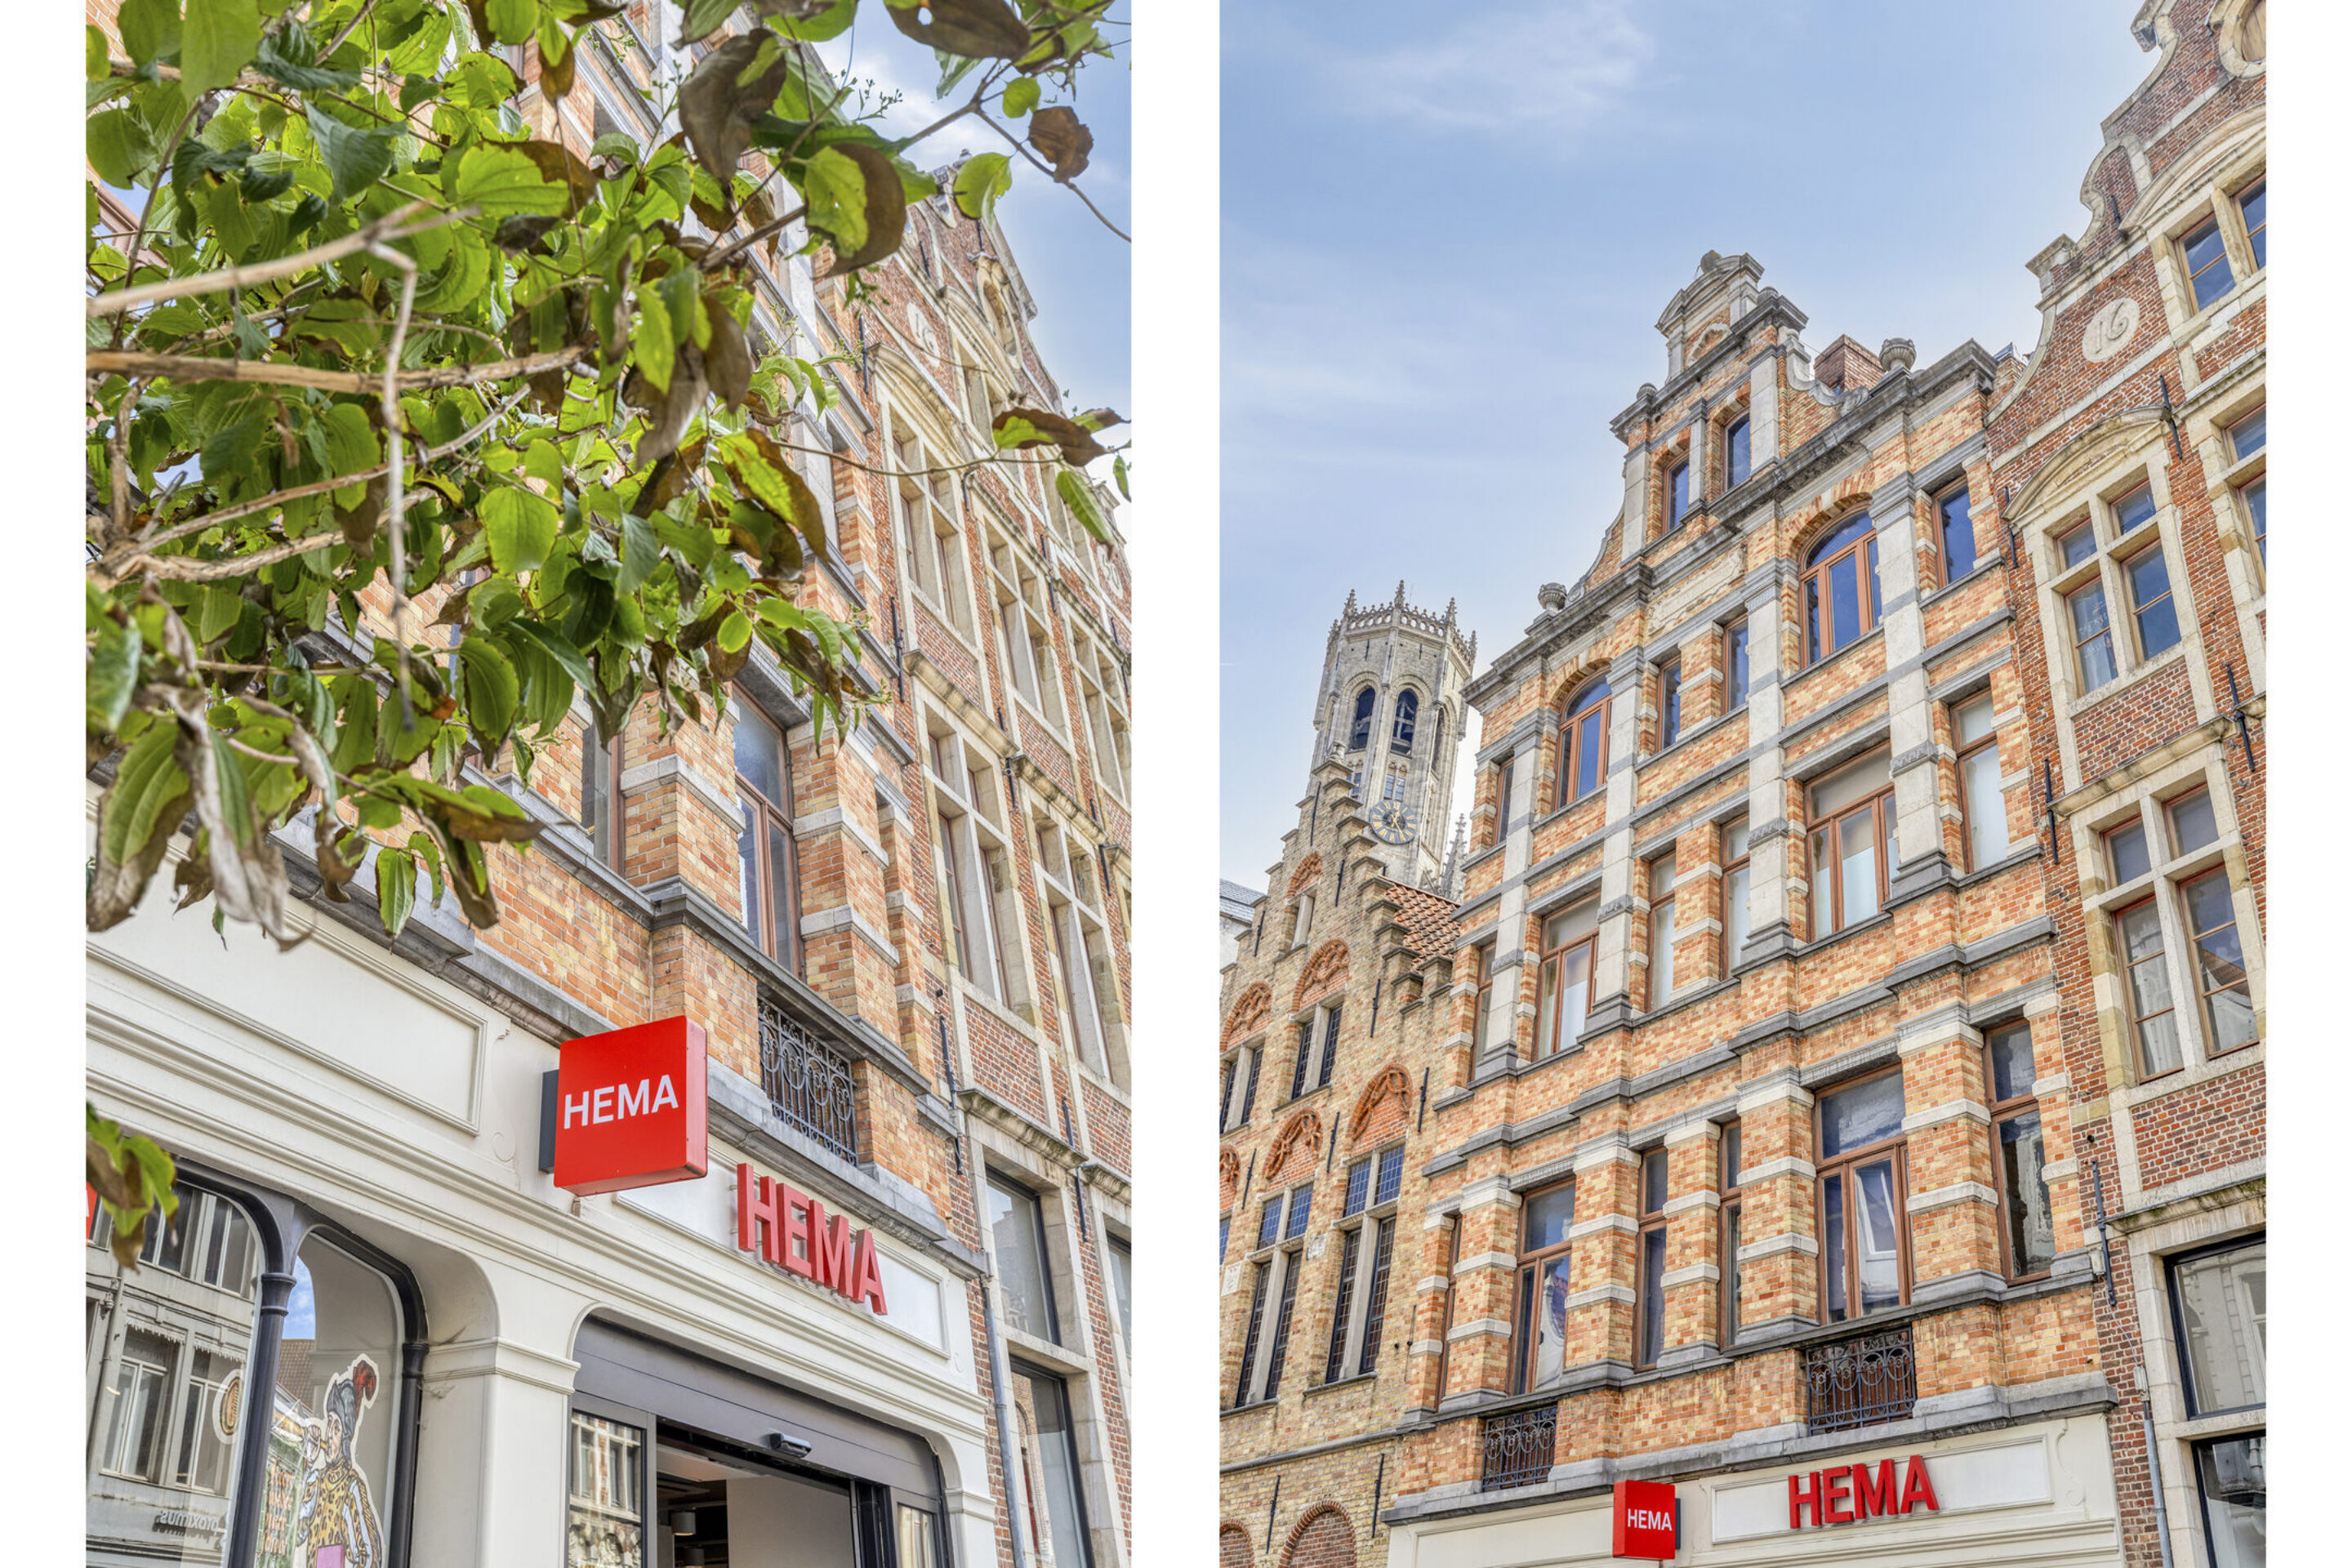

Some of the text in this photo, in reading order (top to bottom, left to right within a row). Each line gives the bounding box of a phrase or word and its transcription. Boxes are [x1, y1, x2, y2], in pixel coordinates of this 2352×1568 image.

[564, 1074, 679, 1129] HEMA
[737, 1162, 888, 1316] HEMA
[1628, 1508, 1673, 1530] HEMA
[1788, 1454, 1940, 1529] HEMA
